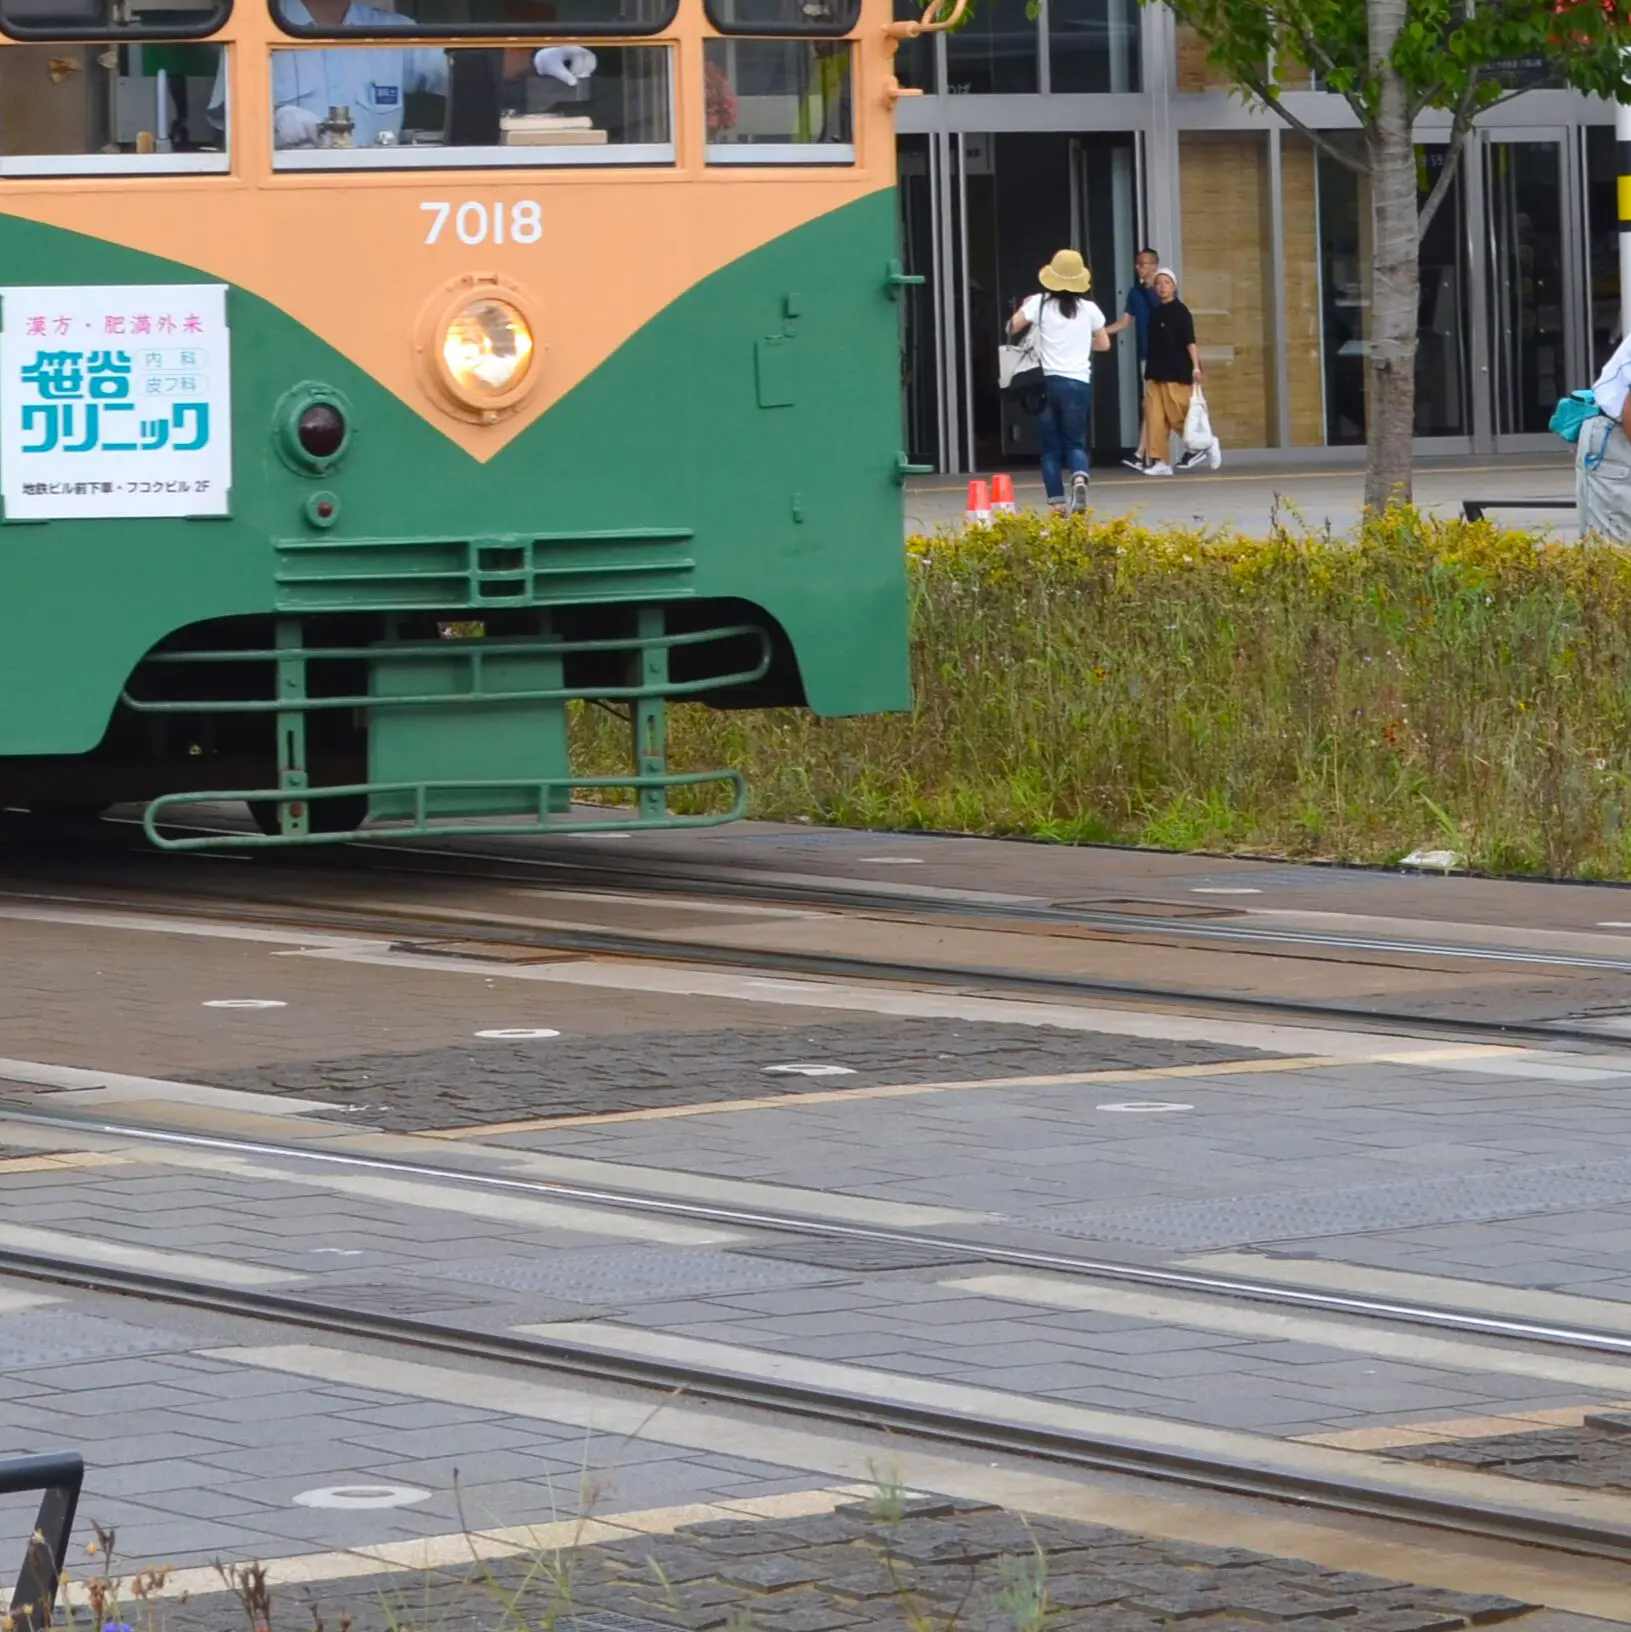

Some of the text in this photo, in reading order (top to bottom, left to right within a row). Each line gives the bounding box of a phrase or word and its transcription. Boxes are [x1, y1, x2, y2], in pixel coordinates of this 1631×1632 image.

[420, 201, 543, 244] 7018
[26, 313, 204, 336] 漢方・肥満外来
[21, 350, 131, 399] 笹谷
[146, 376, 196, 394] 皮フ科
[21, 402, 209, 453] クリニック
[22, 480, 210, 495] 地鉄ビル前下車・フコクビル 2F
